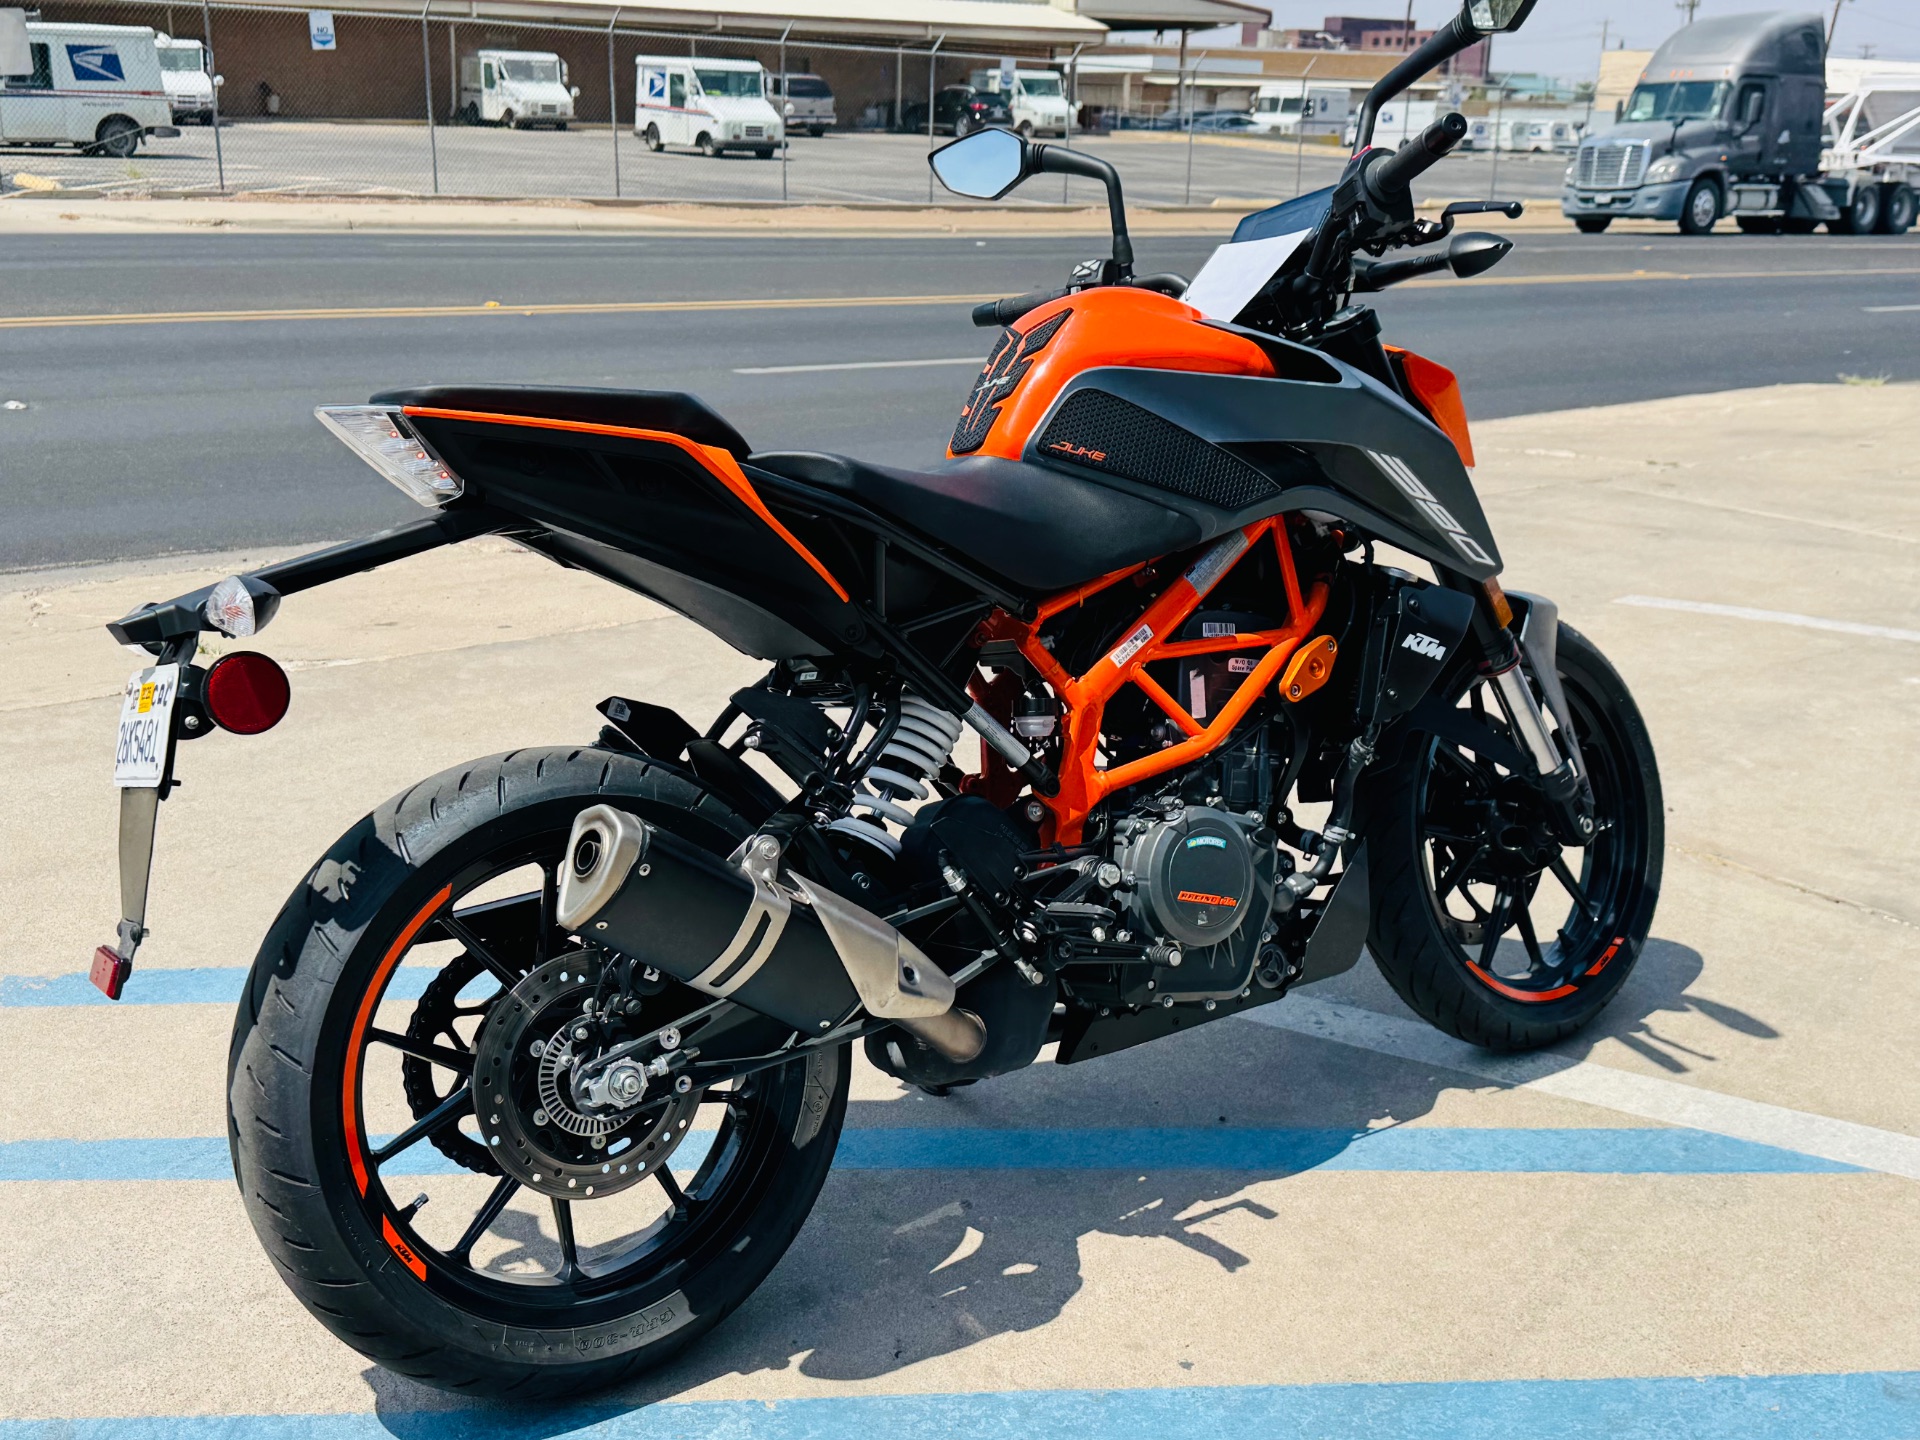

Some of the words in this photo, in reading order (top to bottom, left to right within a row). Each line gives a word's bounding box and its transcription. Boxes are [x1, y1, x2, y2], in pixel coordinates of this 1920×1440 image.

[1049, 441, 1107, 461] DUKE
[1366, 449, 1496, 566] 390
[1401, 632, 1447, 661] KTM
[394, 1244, 413, 1263] KTM
